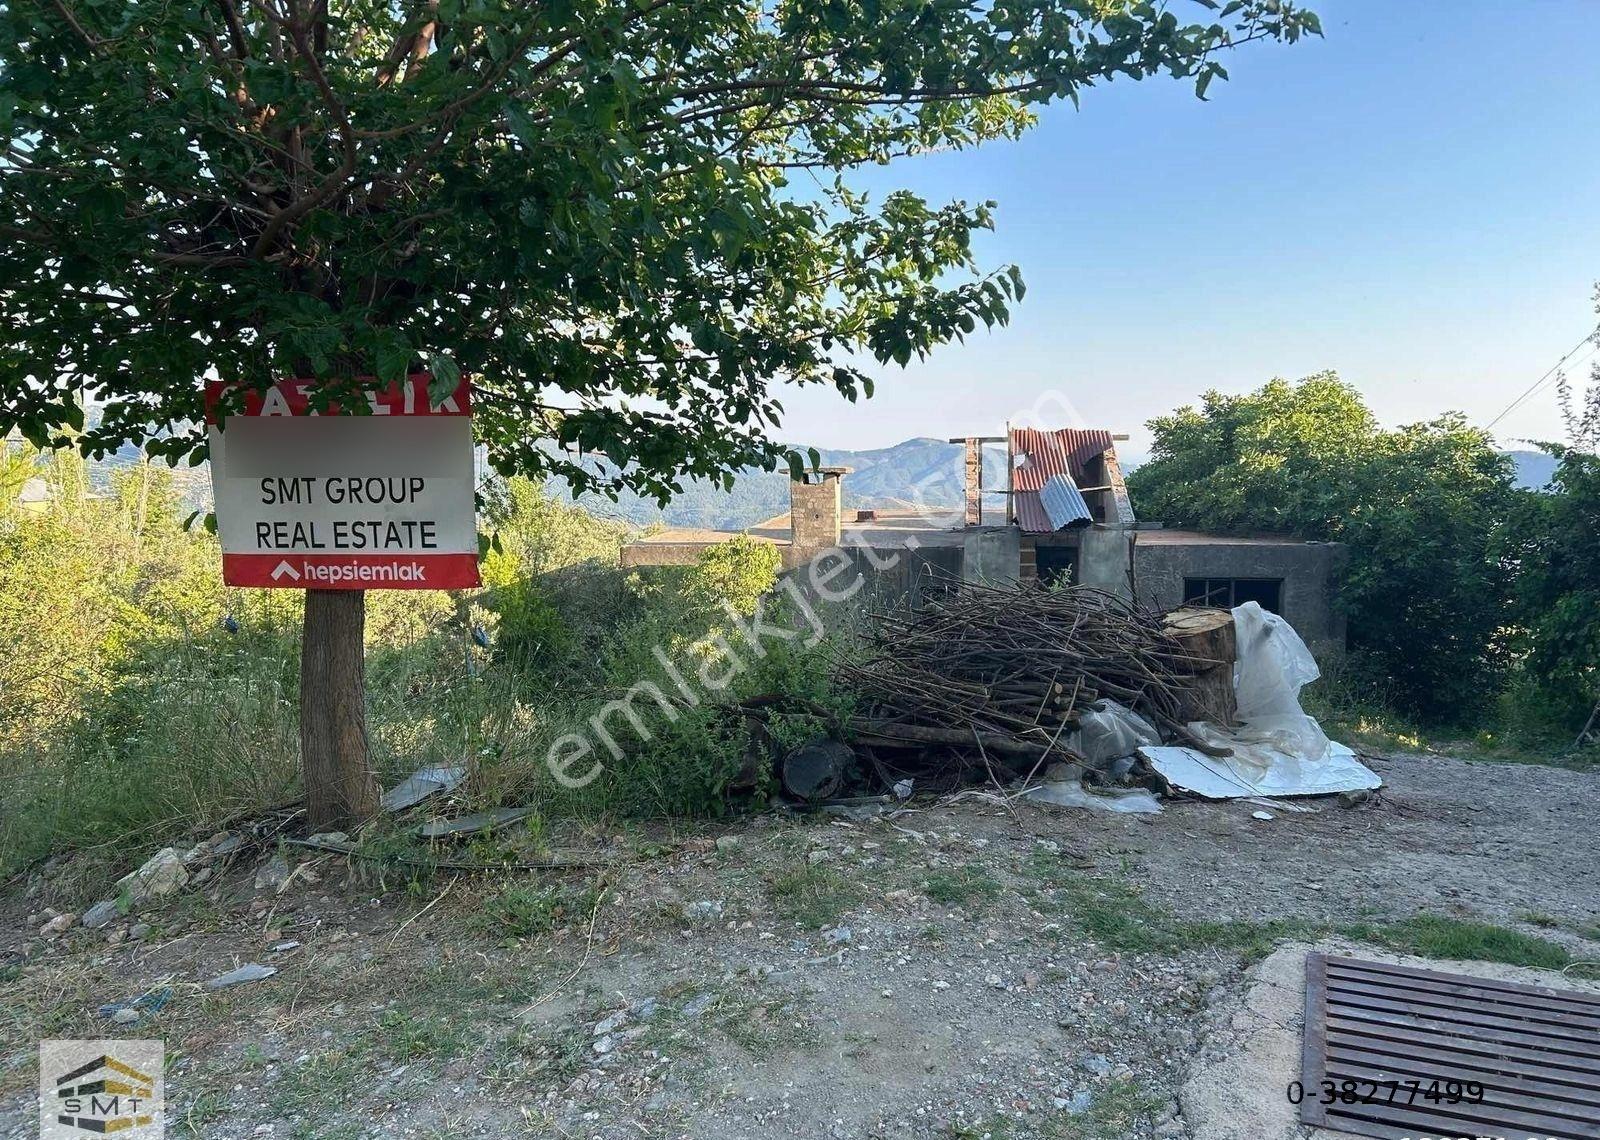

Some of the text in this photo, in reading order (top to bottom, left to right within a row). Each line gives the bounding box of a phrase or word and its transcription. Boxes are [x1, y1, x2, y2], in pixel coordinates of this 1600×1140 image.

[261, 477, 425, 505] SMT GROUP
[256, 521, 437, 549] REAL ESTATE
[303, 560, 426, 584] hepsiemlak
